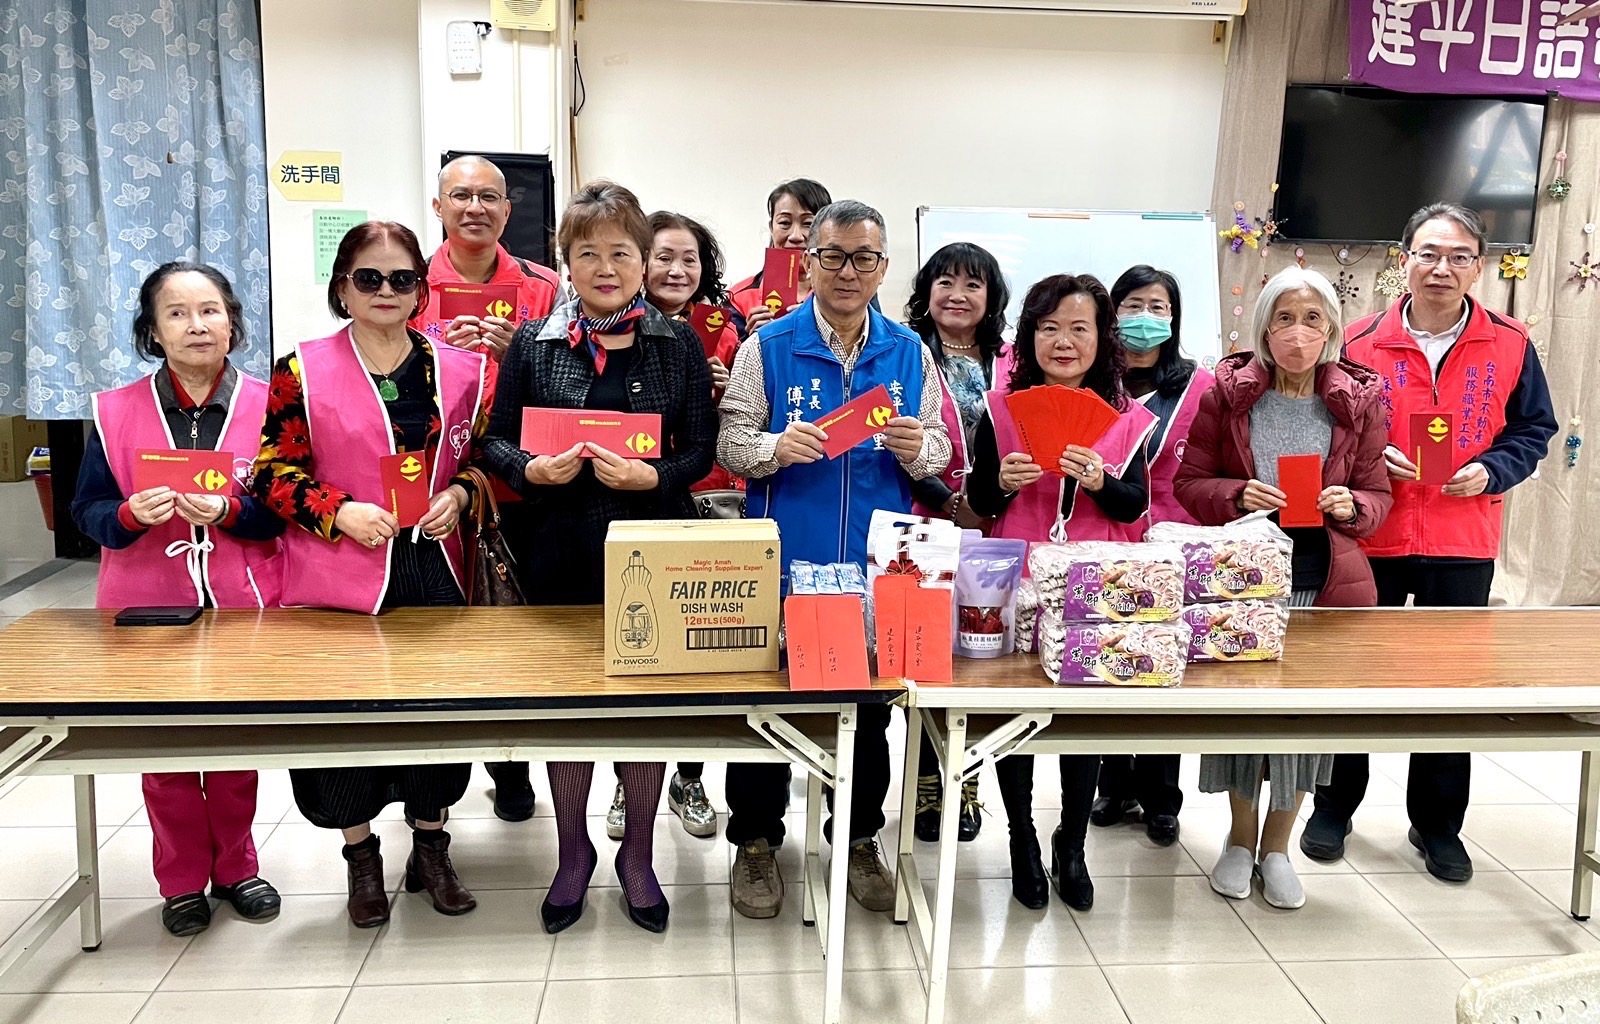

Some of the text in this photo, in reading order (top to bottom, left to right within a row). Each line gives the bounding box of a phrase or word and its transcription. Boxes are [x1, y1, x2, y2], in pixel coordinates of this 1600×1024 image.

[1368, 0, 1600, 79] 建平日語
[280, 164, 341, 184] 洗手間
[809, 378, 822, 410] 里長
[1474, 361, 1496, 443] 台南市不動產
[1457, 366, 1479, 449] 服務職業工會
[693, 559, 712, 567] Magic
[669, 580, 758, 600] FAIR PRICE
[681, 602, 744, 614] DISH WASH
